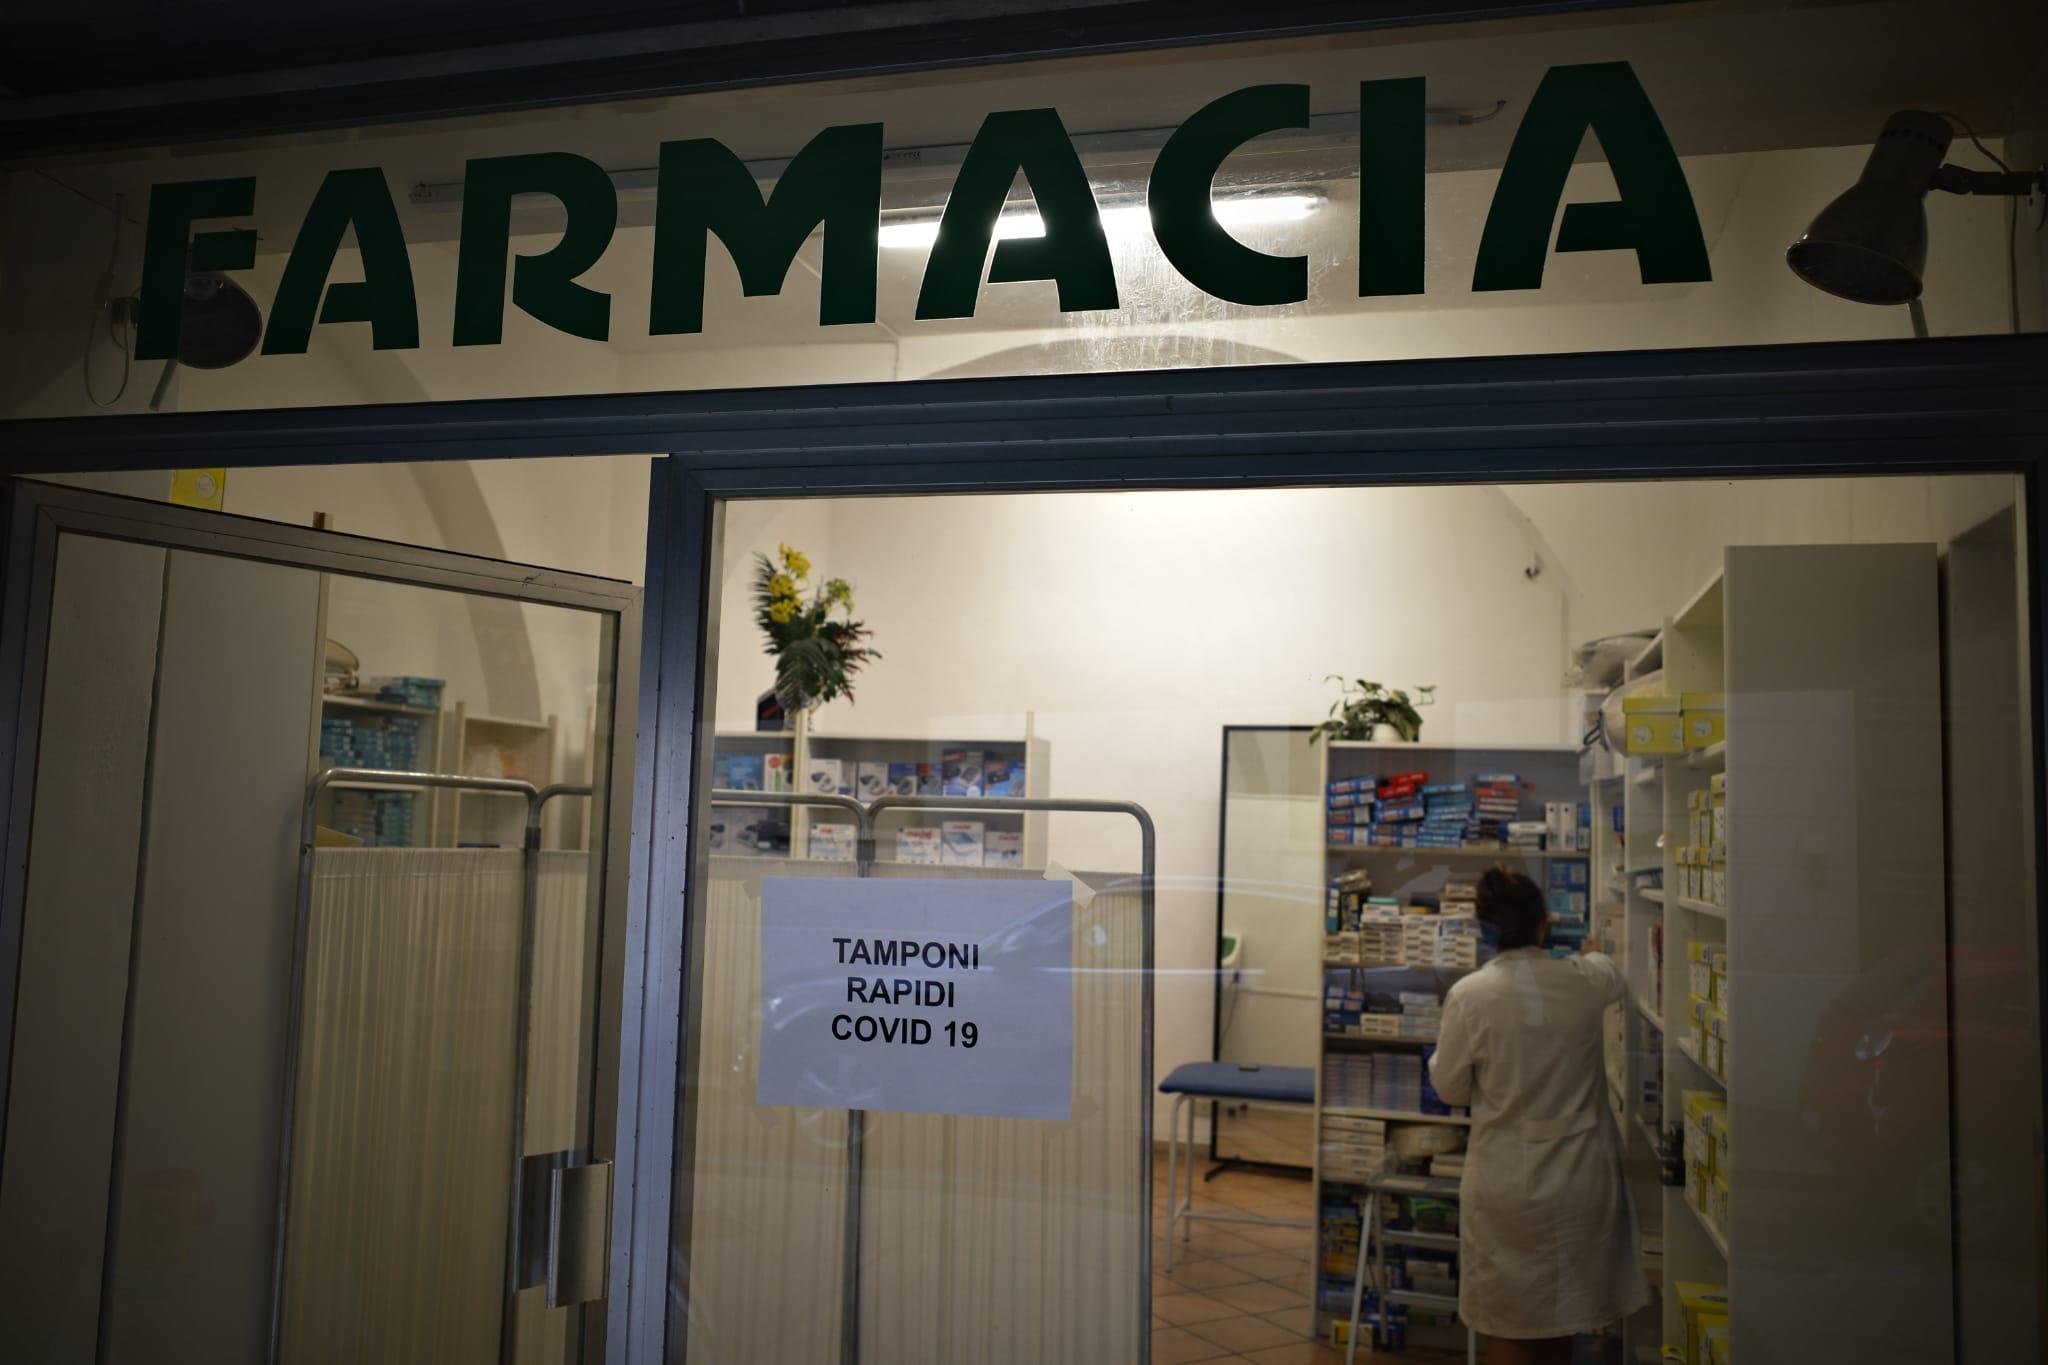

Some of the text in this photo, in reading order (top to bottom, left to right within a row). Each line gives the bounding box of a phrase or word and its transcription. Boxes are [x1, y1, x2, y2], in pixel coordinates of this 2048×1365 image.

[135, 61, 1712, 360] FARMACIA
[832, 937, 979, 969] TAMPONI
[847, 976, 955, 1008] RAPIDI
[831, 1013, 979, 1049] COVID 19
